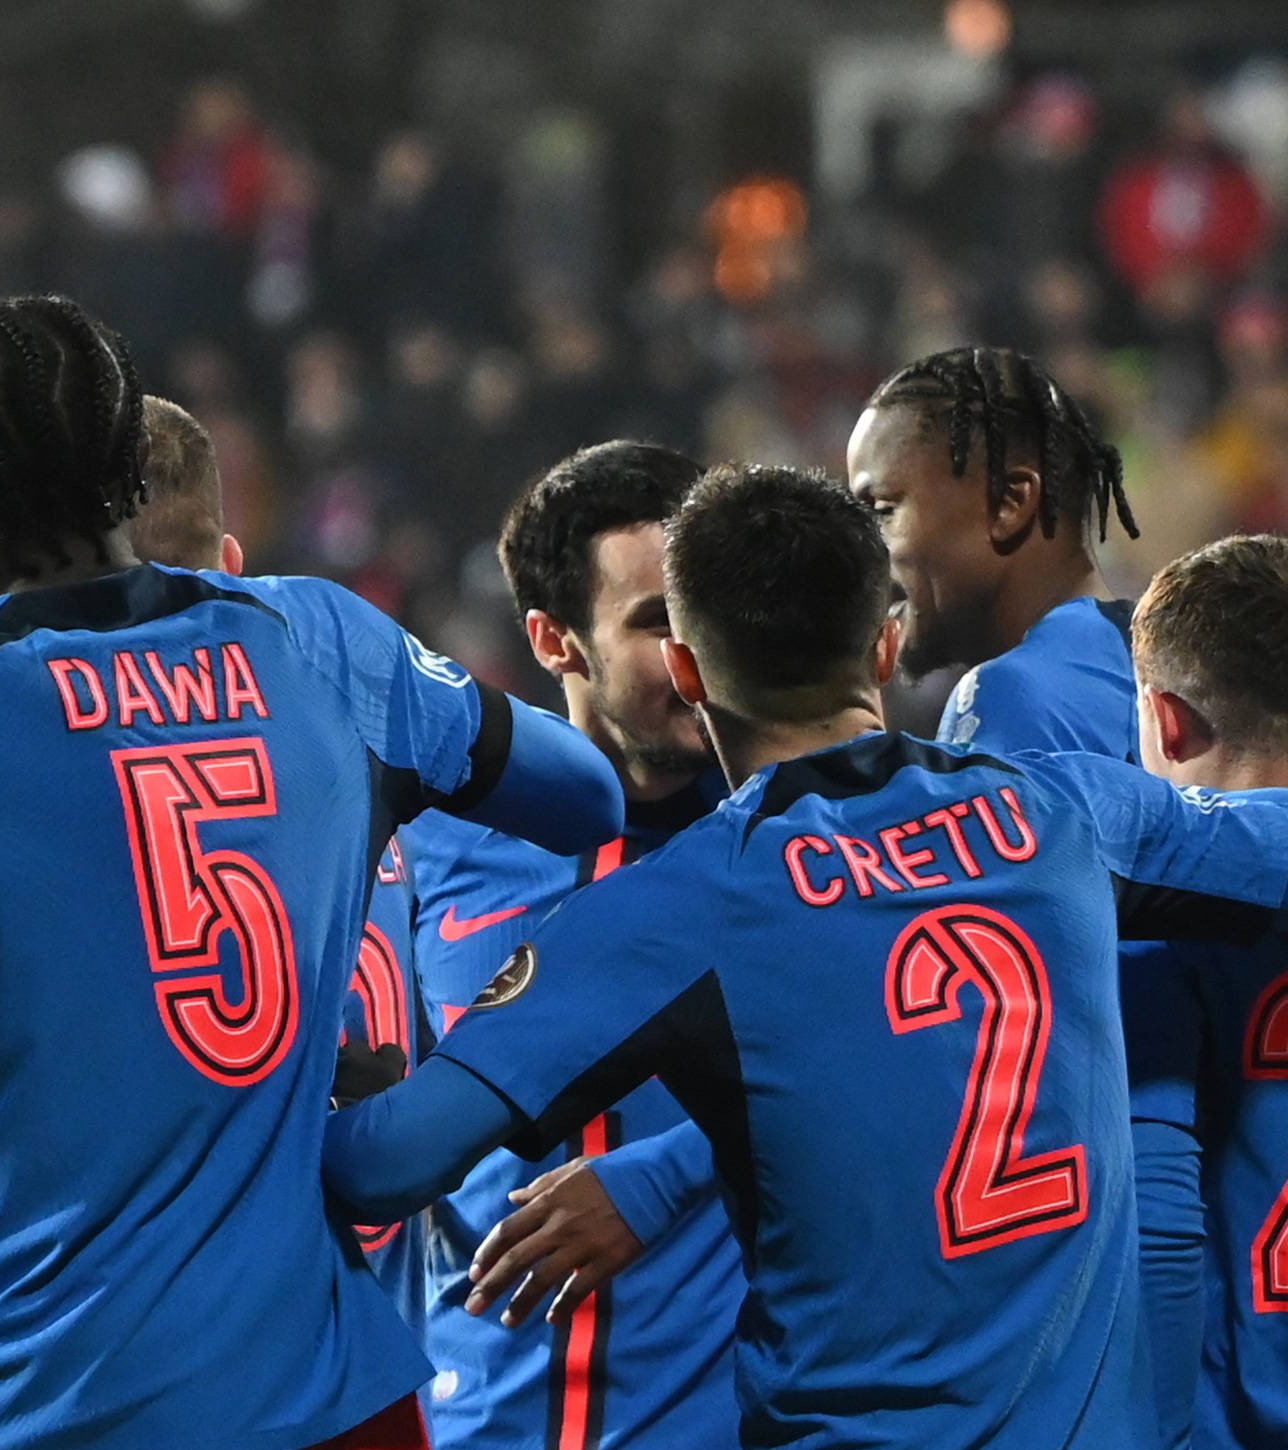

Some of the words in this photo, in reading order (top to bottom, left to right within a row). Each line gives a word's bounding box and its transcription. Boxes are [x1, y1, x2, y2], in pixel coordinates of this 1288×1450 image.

[47, 642, 270, 731] DAWA
[110, 736, 300, 1087] 5
[782, 786, 1038, 906] CRETU
[884, 903, 1088, 1260] 2
